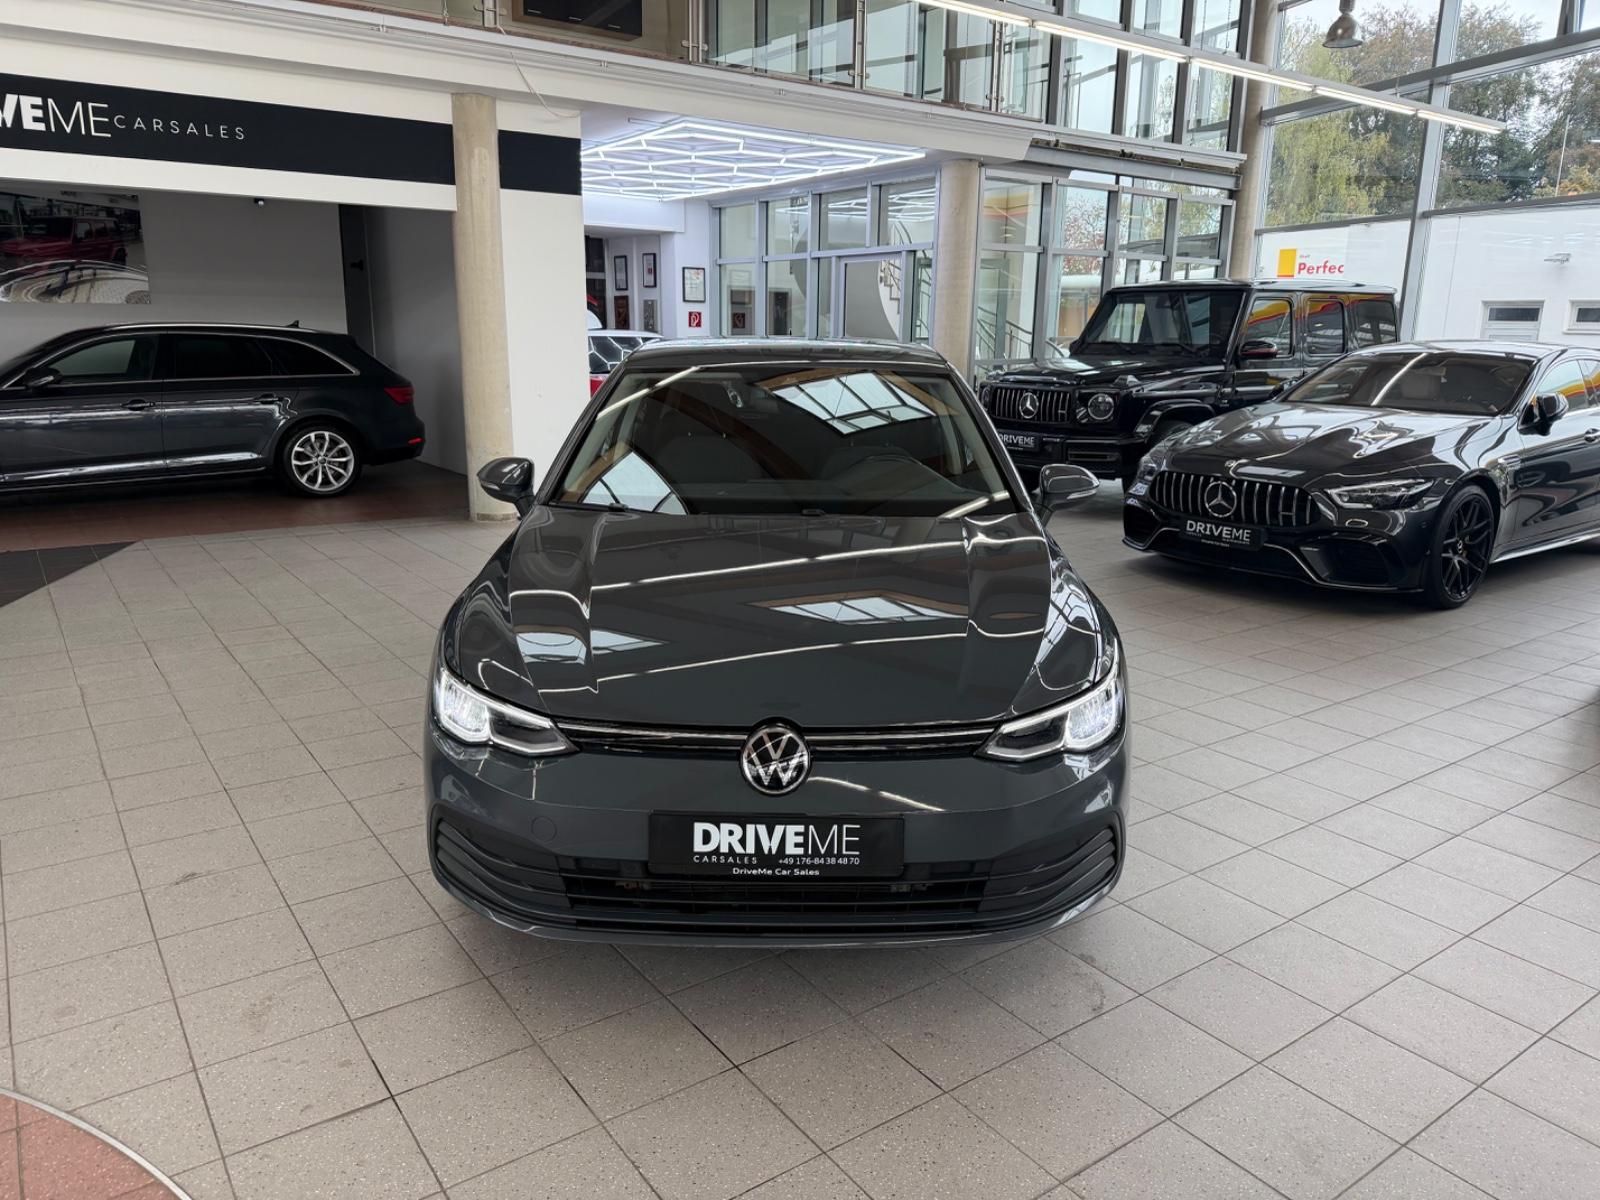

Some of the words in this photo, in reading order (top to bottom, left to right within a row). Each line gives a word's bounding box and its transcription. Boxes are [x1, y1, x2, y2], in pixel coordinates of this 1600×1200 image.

[113, 114, 245, 140] CARSALES
[1186, 520, 1251, 541] DRIVEME
[693, 822, 861, 855] DRIVEME
[693, 855, 757, 864] CARSALES
[732, 867, 773, 875] DriveMe
[775, 868, 791, 876] Car
[793, 868, 820, 876] Sales
